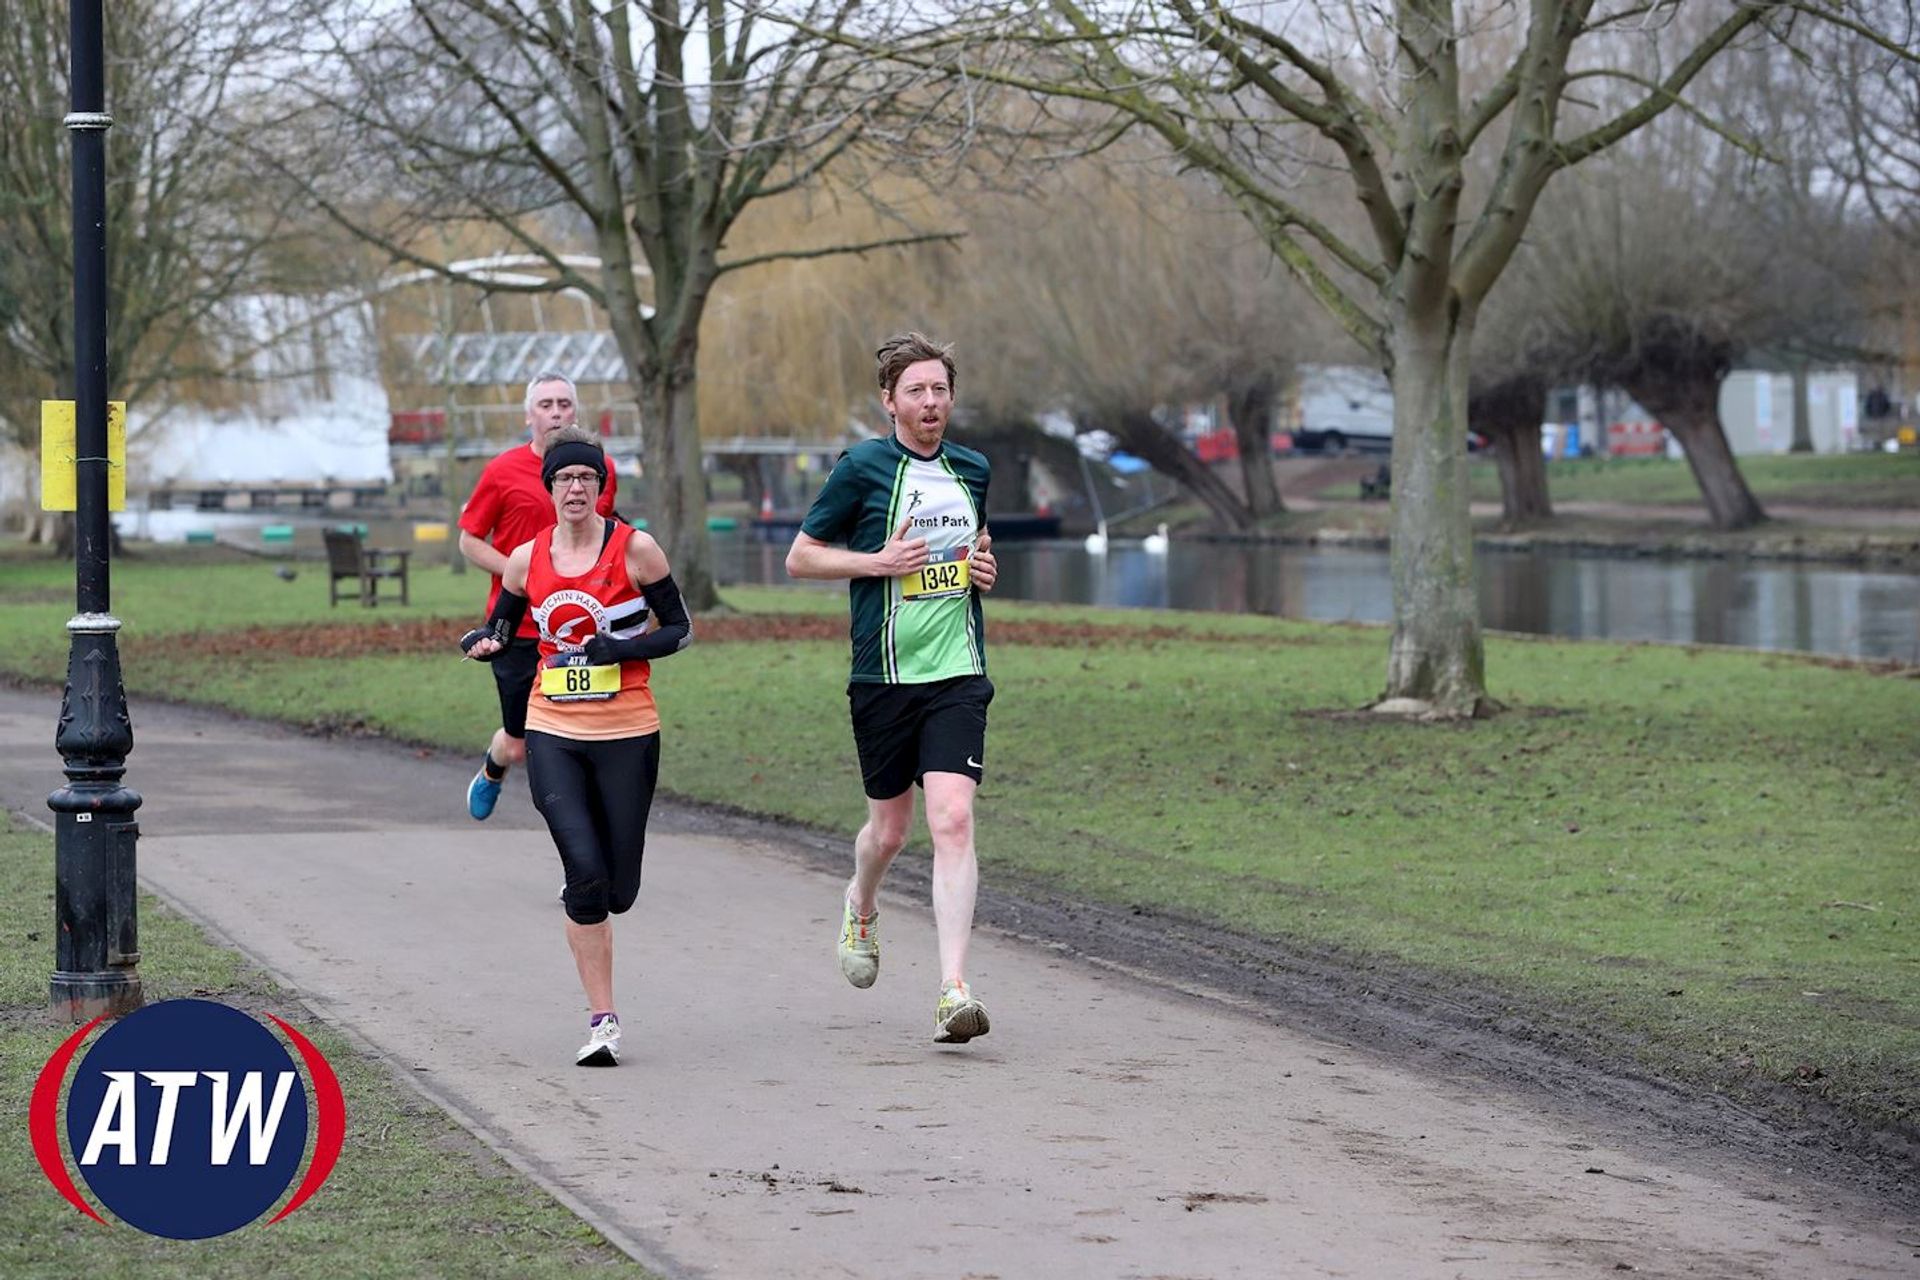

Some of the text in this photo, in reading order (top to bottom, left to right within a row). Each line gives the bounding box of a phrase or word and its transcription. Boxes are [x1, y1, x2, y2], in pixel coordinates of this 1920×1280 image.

[910, 516, 970, 527] rent Park
[921, 565, 960, 590] 1342
[540, 593, 606, 623] HITCHIN HARES
[568, 656, 588, 666] ATW
[566, 669, 591, 691] 68
